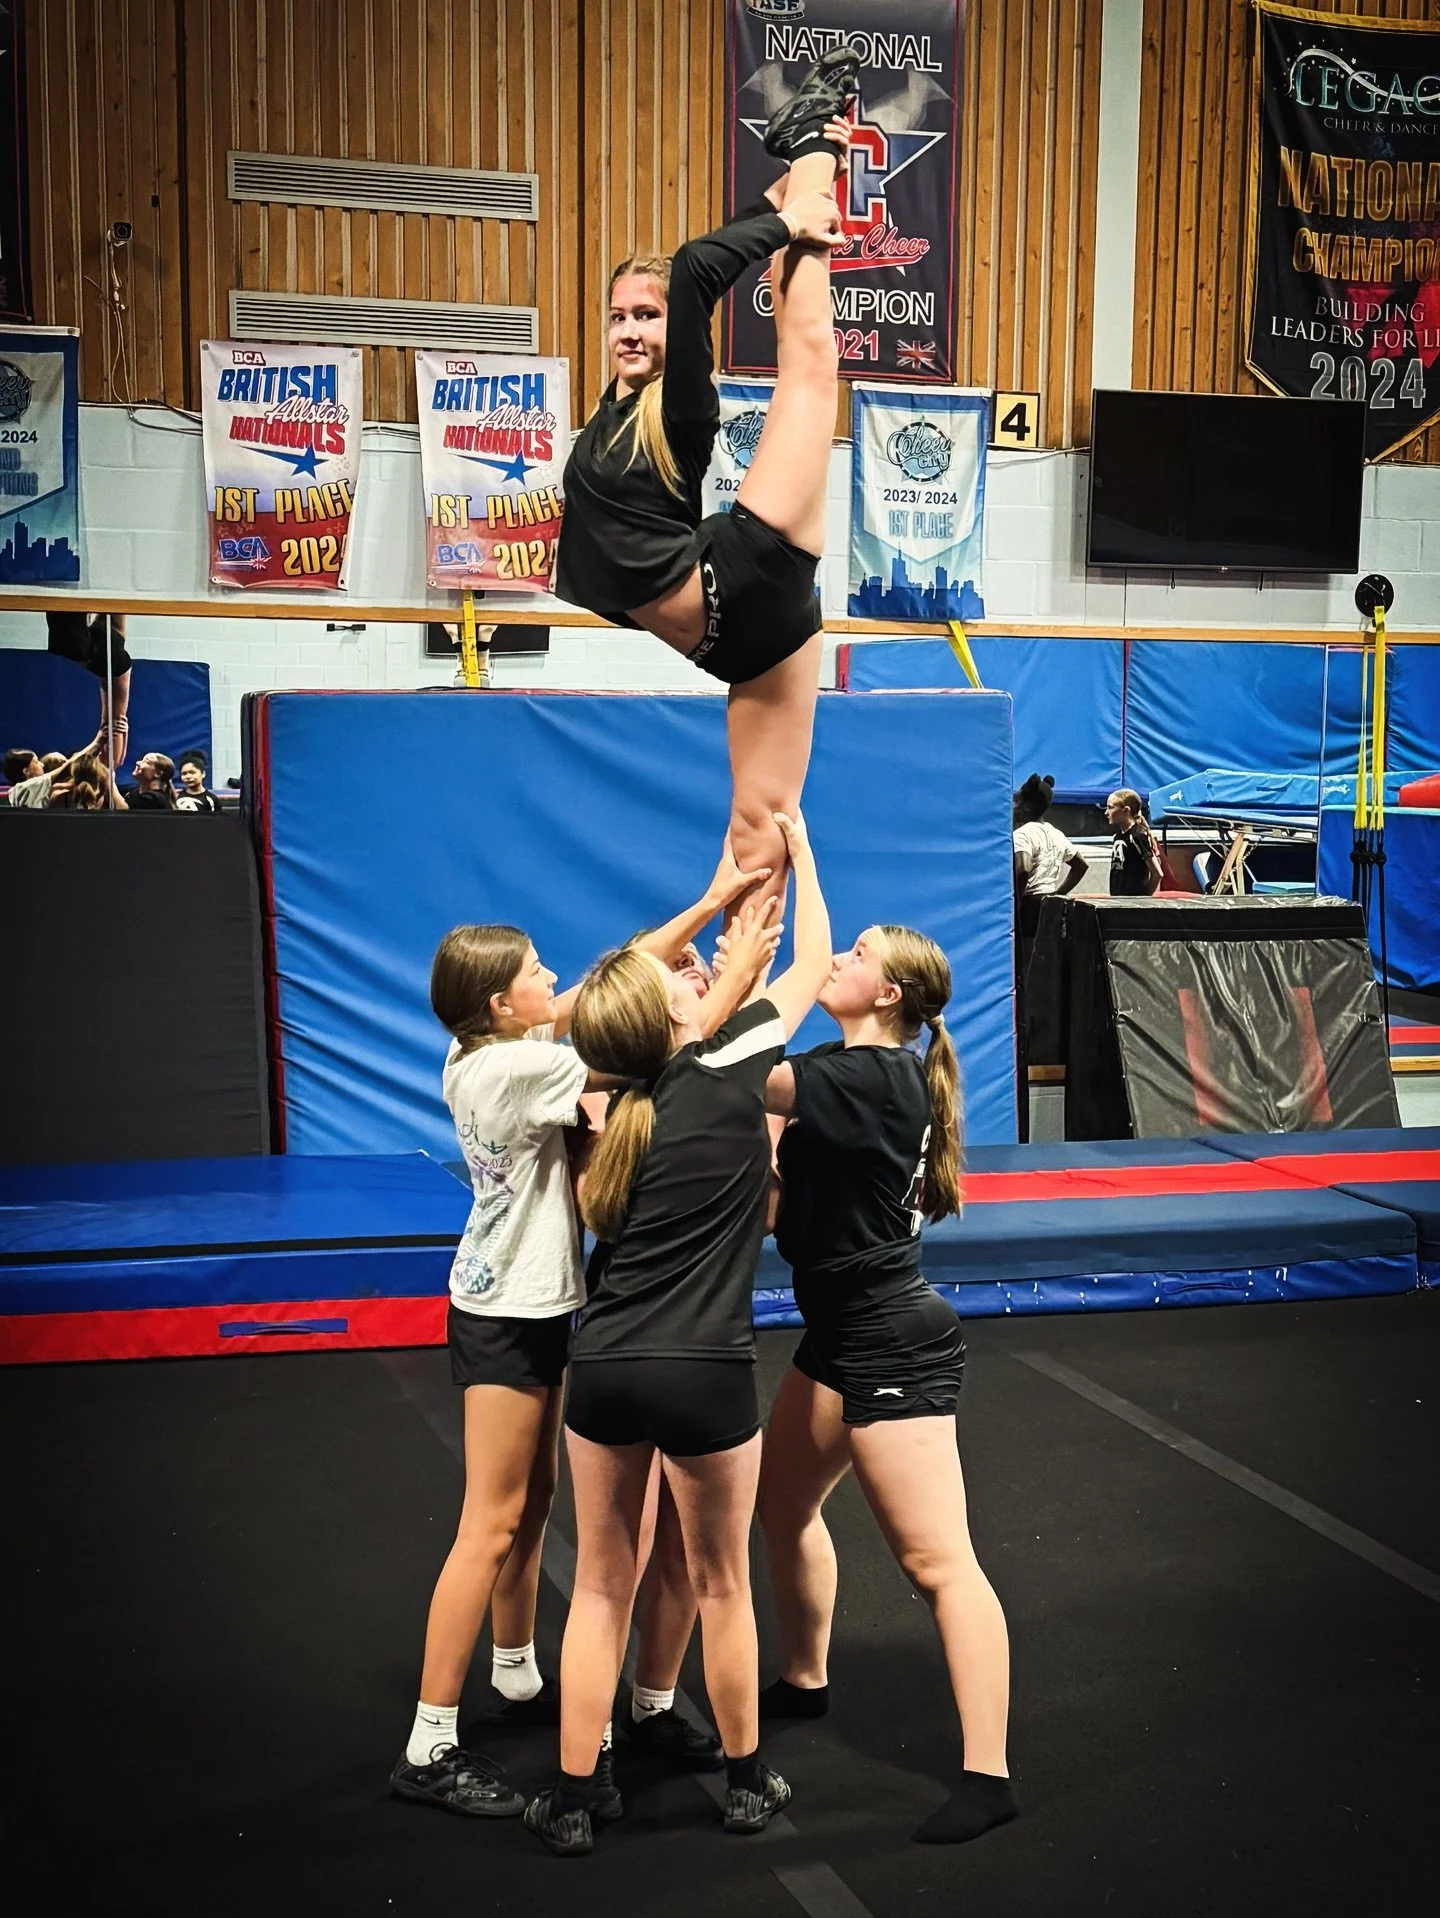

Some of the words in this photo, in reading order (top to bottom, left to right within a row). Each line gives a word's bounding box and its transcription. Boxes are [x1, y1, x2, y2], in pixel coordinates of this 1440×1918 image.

[1294, 62, 1440, 115] LEGAC
[1323, 117, 1371, 132] CHEER
[1278, 145, 1440, 222] NATIONA
[861, 223, 930, 260] Cheer
[753, 283, 935, 326] CMPION
[1315, 296, 1425, 322] BUILDING
[1271, 316, 1364, 347] LEADERS
[1372, 328, 1416, 348] FOR
[1424, 328, 1440, 347] LI
[233, 350, 266, 365] BCA
[446, 361, 478, 374] BCA
[217, 365, 338, 405] BRITISH
[432, 373, 547, 413] BRITISH
[1310, 352, 1426, 409] 2024
[264, 395, 349, 424] Allstar
[477, 404, 556, 432] Allstar
[1000, 402, 1031, 441] 4
[1, 430, 38, 443] 2024
[229, 416, 345, 455] NATIONALS
[443, 425, 553, 461] NATIONALS
[275, 478, 354, 524] PLACE
[715, 478, 741, 491] 202
[925, 491, 958, 504] 2024
[486, 484, 563, 529] PLACE
[912, 511, 954, 539] PLACE
[219, 536, 270, 560] BCA
[281, 534, 347, 576] 202
[437, 542, 482, 564] BCA
[493, 538, 557, 580] 202
